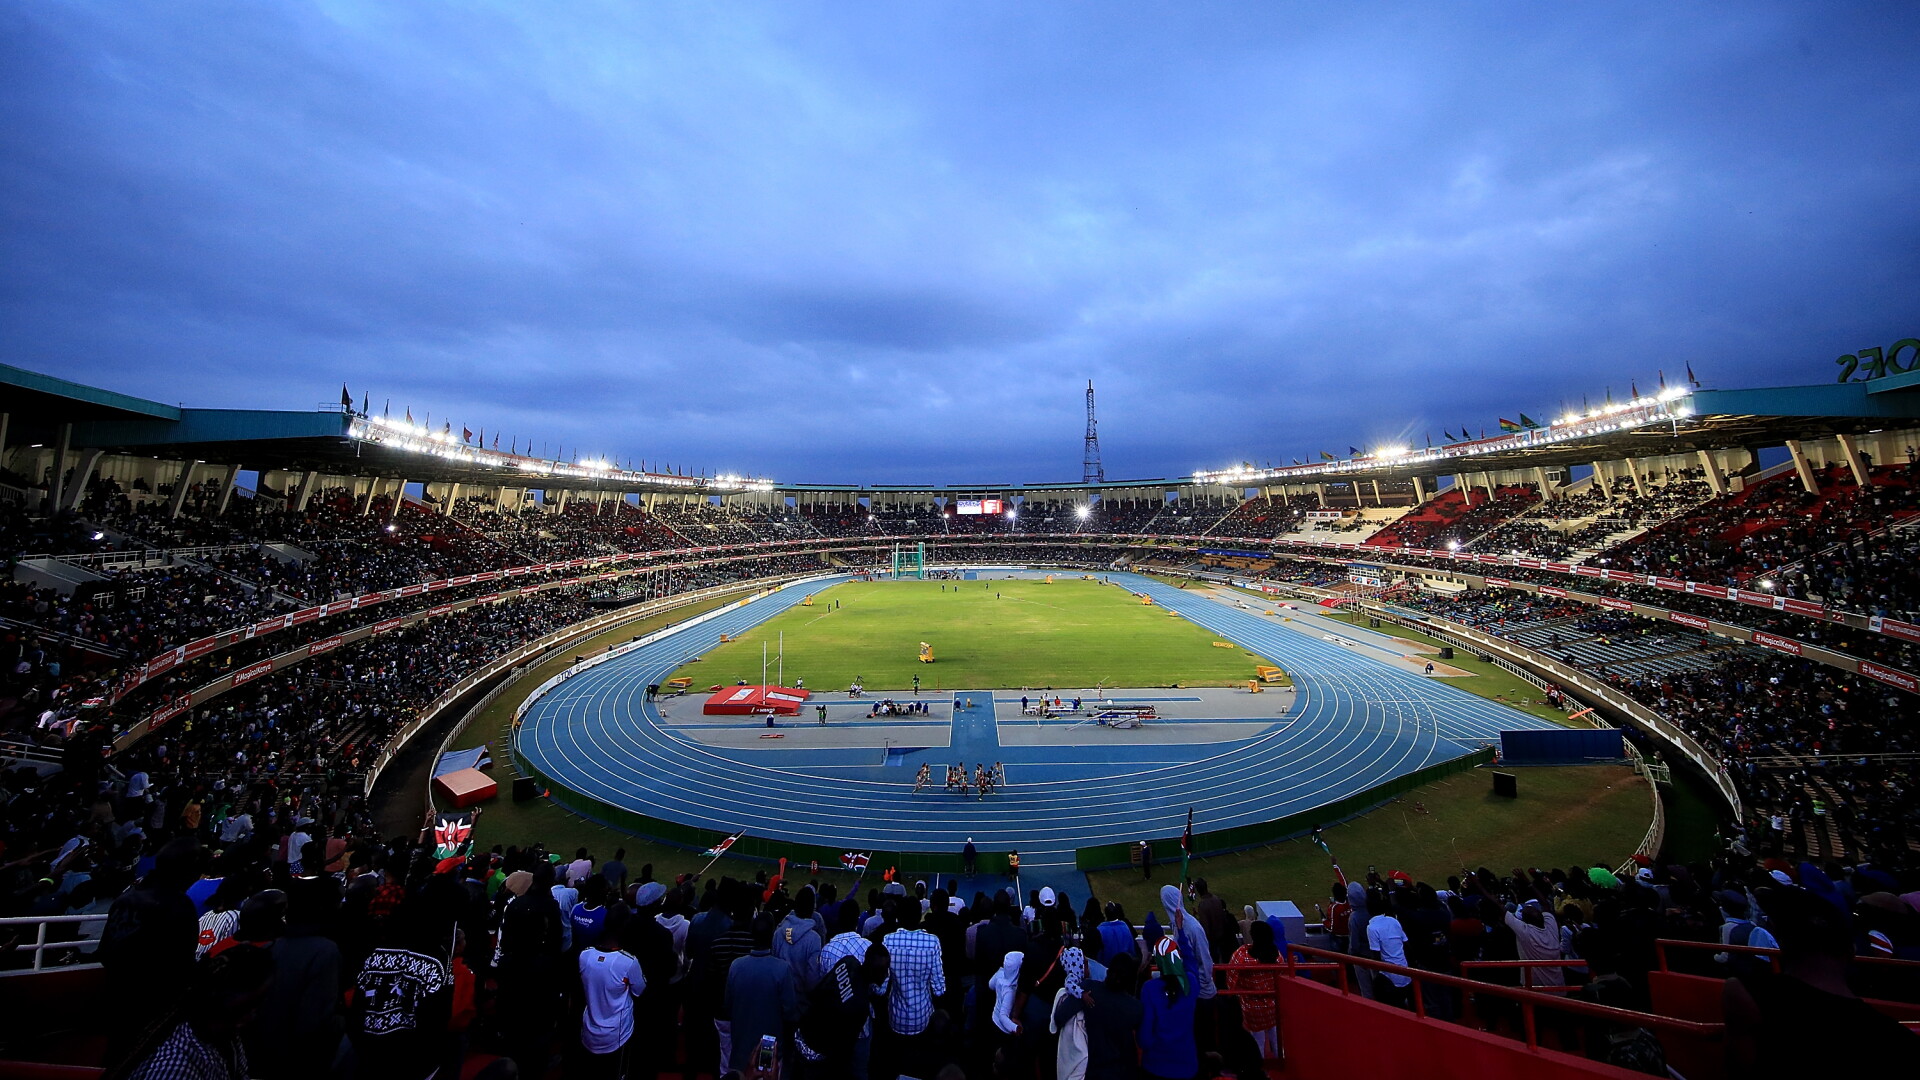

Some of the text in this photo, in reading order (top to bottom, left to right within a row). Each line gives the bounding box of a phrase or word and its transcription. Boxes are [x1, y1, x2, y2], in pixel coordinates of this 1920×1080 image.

[234, 663, 271, 684] #MagicalKenya
[560, 668, 573, 681] TDK
[1862, 664, 1914, 689] #MagicalKenya
